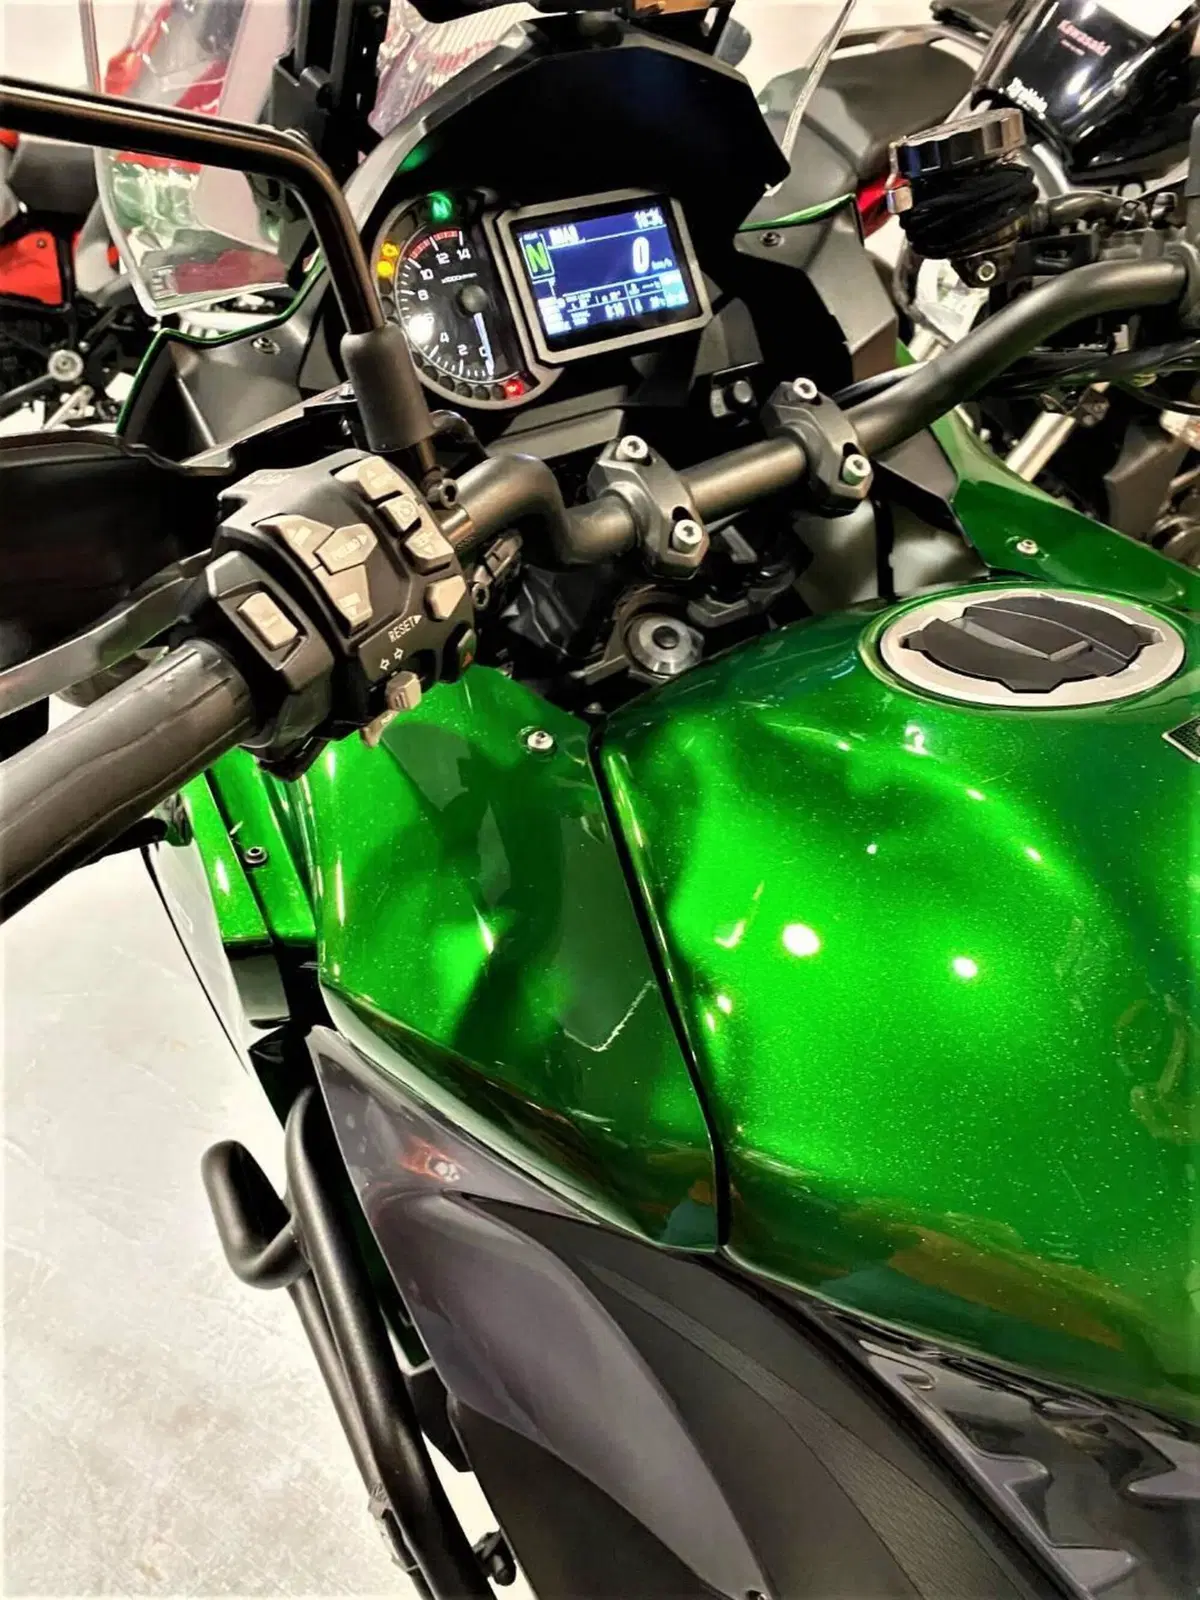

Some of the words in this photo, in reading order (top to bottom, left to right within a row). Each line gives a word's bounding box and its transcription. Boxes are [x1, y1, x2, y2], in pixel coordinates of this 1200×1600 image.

[435, 253, 450, 264] 12
[456, 248, 471, 261] 14
[525, 241, 550, 273] N
[632, 236, 650, 274] 0
[420, 268, 434, 281] 10
[417, 289, 429, 301] 8
[439, 331, 449, 343] 4
[457, 344, 468, 356] 2
[388, 620, 416, 642] RESET
